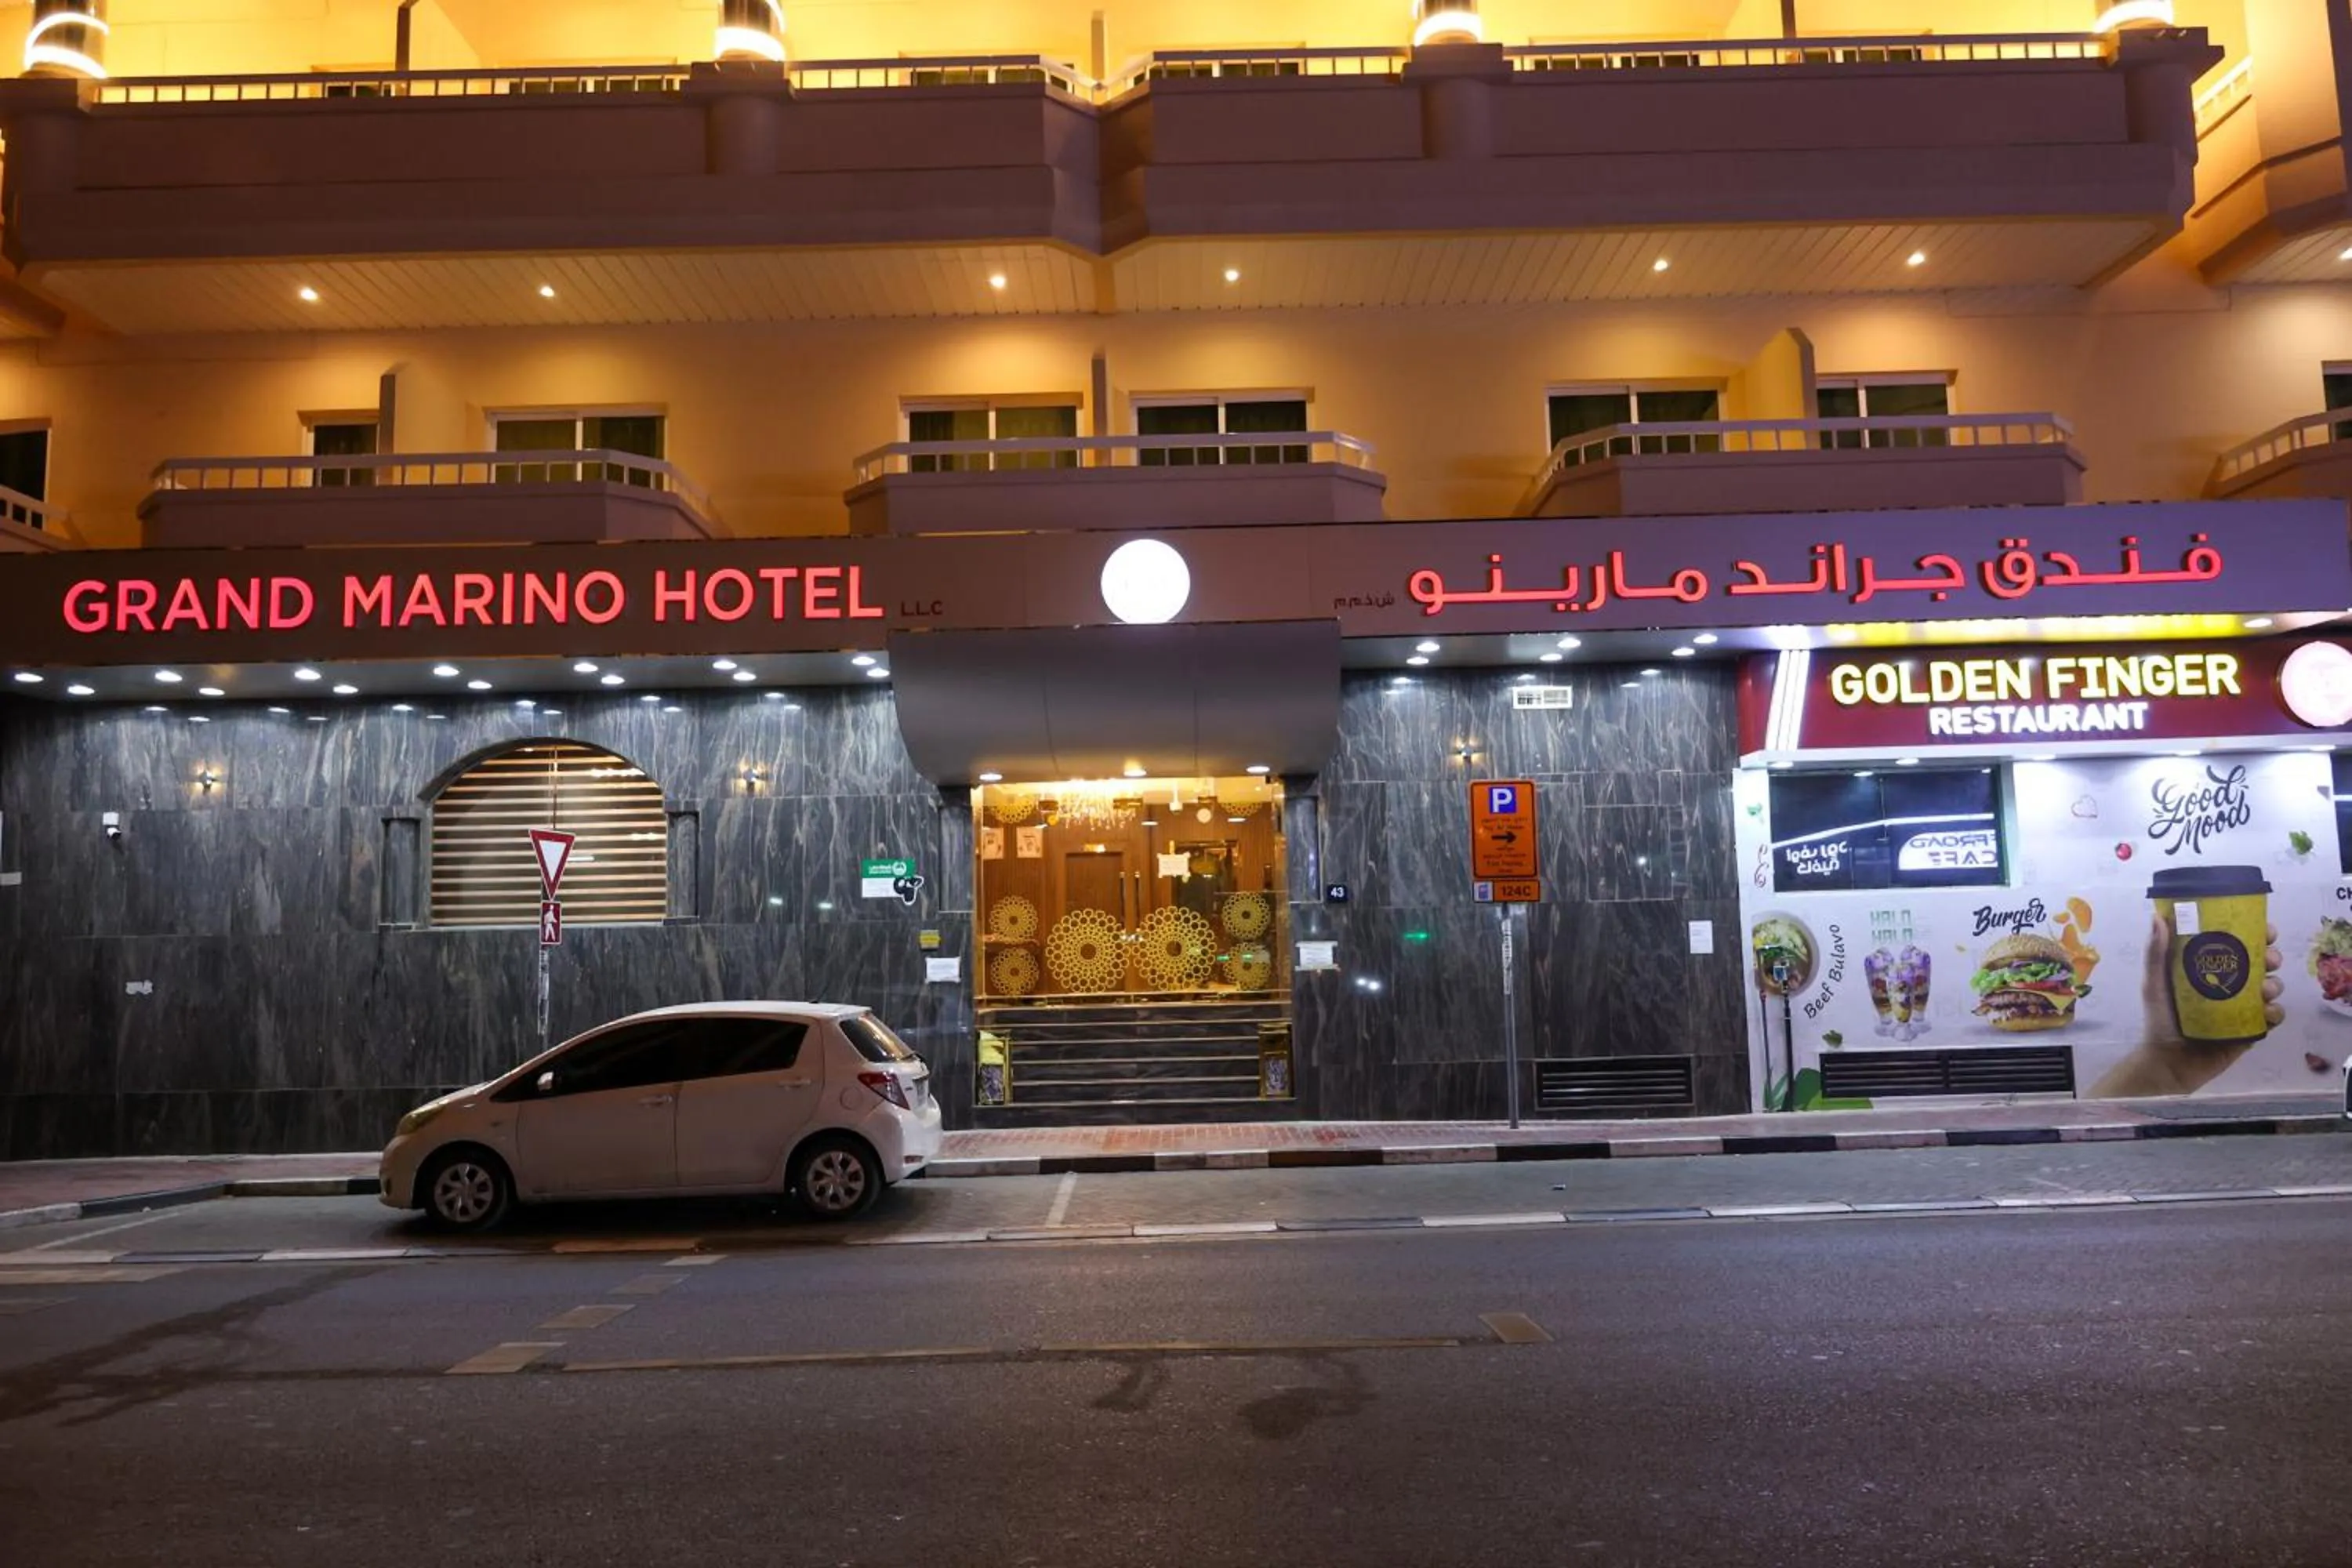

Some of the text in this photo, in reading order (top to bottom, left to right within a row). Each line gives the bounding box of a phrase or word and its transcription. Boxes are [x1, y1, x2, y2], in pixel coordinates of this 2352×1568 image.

[1408, 533, 2223, 616] فندق جراند مارينو
[63, 564, 885, 633] GRAND MARINO HOTEL
[1830, 653, 2241, 705] GOLDEN FINGER
[1929, 702, 2148, 735] RESTAURANT
[1492, 788, 1512, 813] P
[2148, 765, 2248, 839] Good
[2165, 790, 2251, 855] Mood
[1330, 887, 1345, 898] 43
[1501, 885, 1531, 896] 124C
[1972, 898, 2047, 937] Burger
[1804, 982, 1834, 1019] Beef
